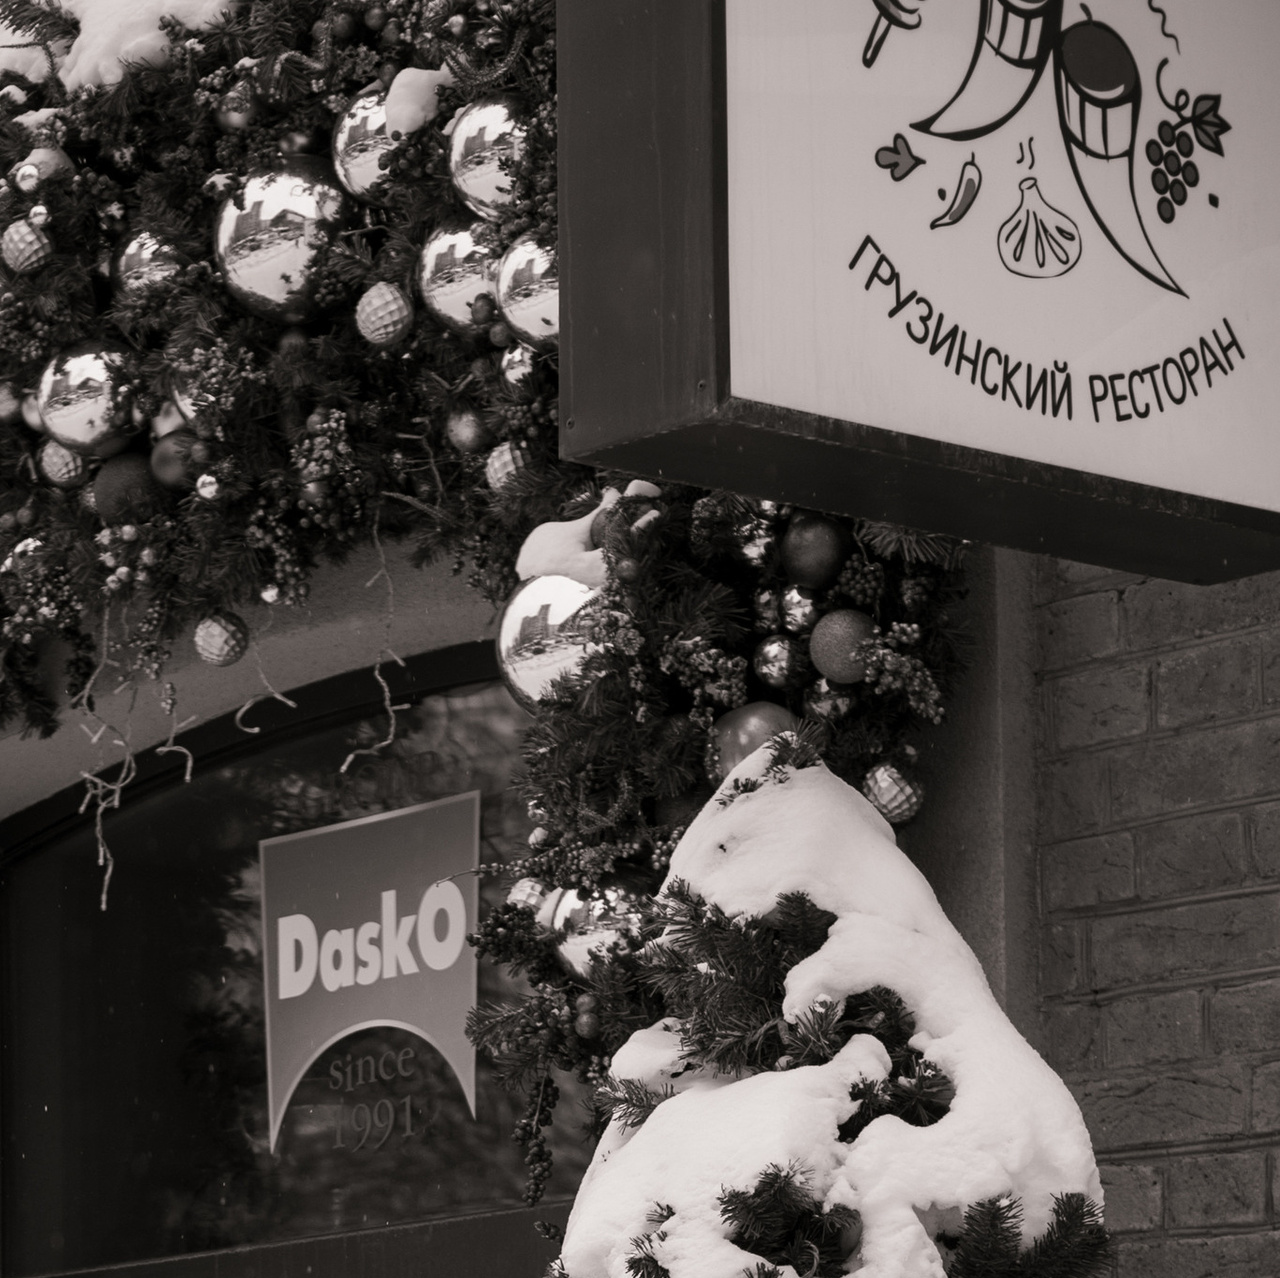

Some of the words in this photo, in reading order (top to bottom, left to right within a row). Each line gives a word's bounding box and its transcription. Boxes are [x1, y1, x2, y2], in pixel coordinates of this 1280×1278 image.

[848, 234, 1073, 421] ГРУЗИНСКИЙ
[1088, 317, 1246, 423] РЕСТОРАН
[328, 1046, 416, 1093] since
[332, 1094, 417, 1154] 1991
